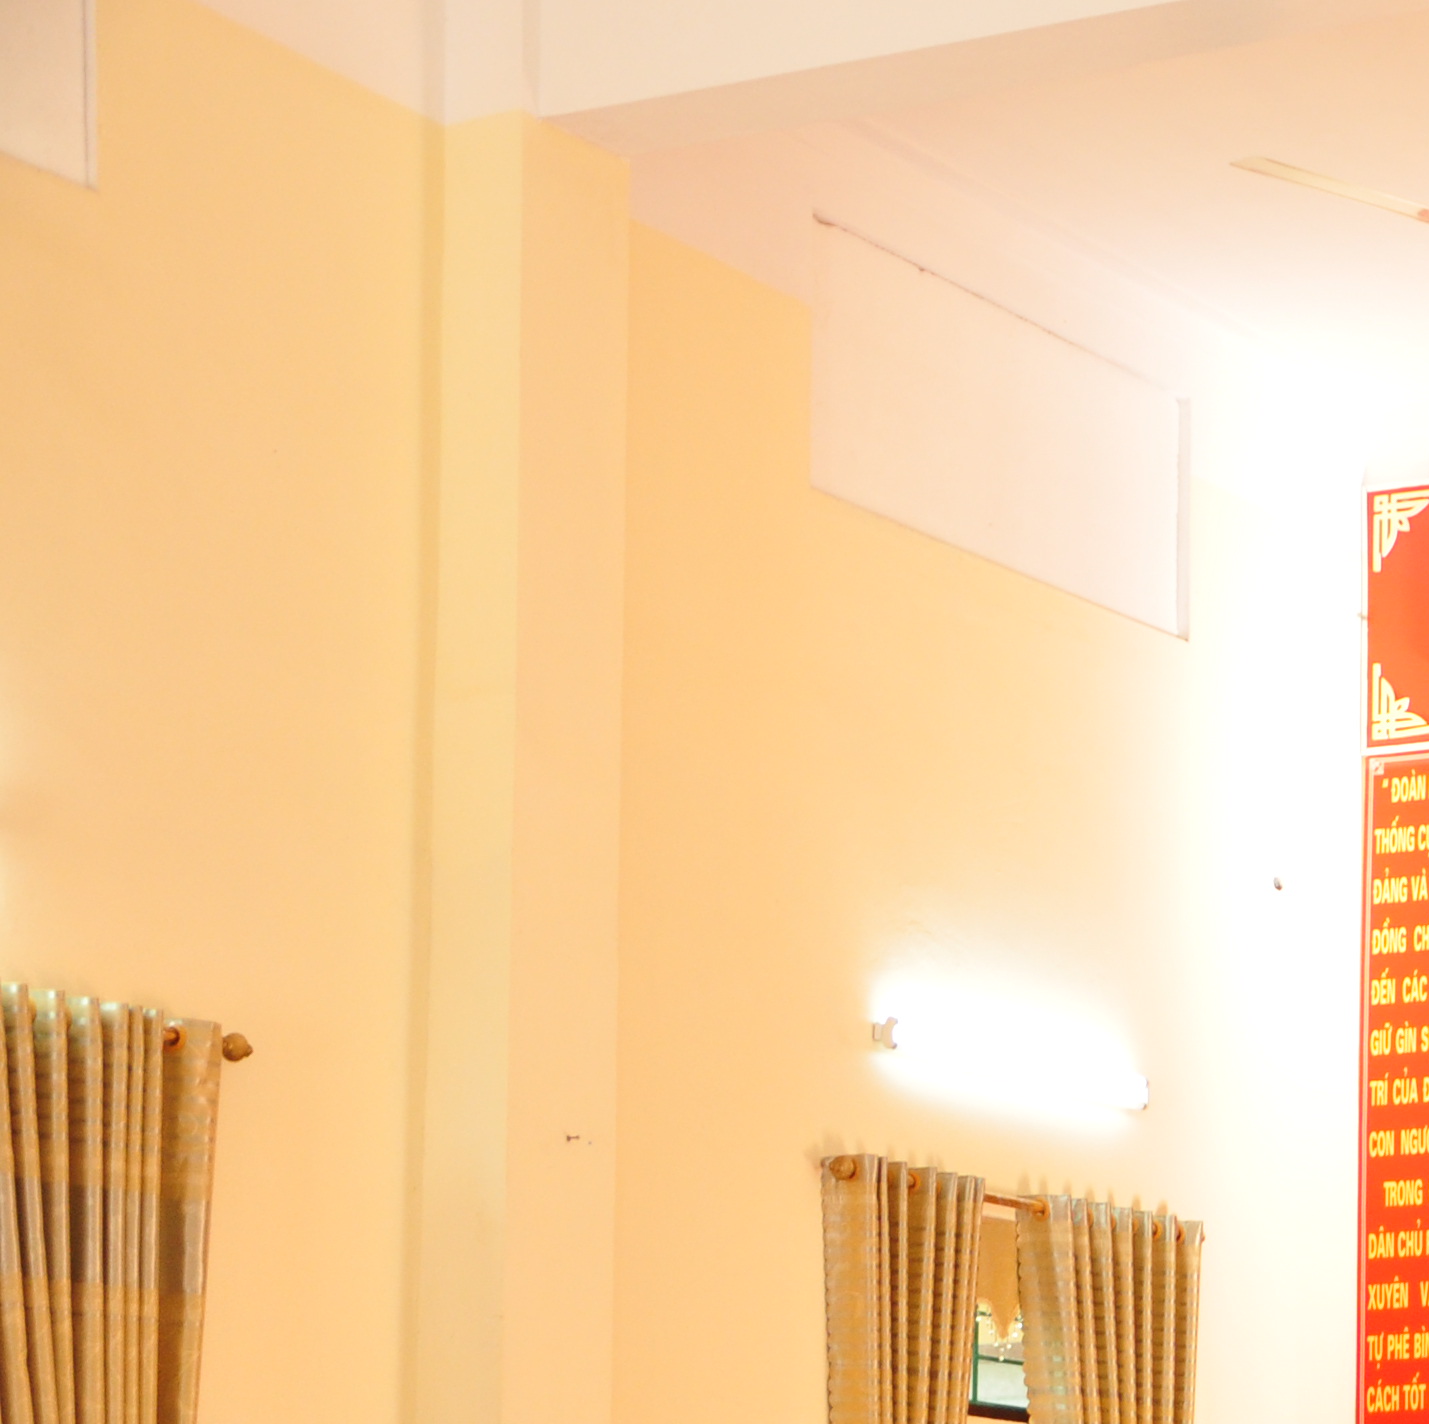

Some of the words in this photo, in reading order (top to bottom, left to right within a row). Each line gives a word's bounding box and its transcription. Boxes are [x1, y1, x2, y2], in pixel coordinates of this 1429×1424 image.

[1391, 771, 1426, 803] ĐOÀN
[1374, 816, 1415, 854] THỐNG
[1373, 868, 1408, 904] ĐẢNG
[1371, 968, 1395, 1005] ĐẾN
[1402, 970, 1427, 1003] CÁC
[1396, 1021, 1417, 1054] GÌN
[1393, 1068, 1418, 1105] CỦA
[1369, 1131, 1394, 1157] CON
[1383, 1179, 1423, 1206] TRONG
[1368, 1226, 1394, 1259] DÂN
[1398, 1219, 1423, 1257] CHỦ
[1368, 1276, 1408, 1310] XUYÊN
[1387, 1327, 1410, 1360] PHÊ
[1367, 1379, 1399, 1412] CÁCH
[1403, 1373, 1426, 1410] TỐT
